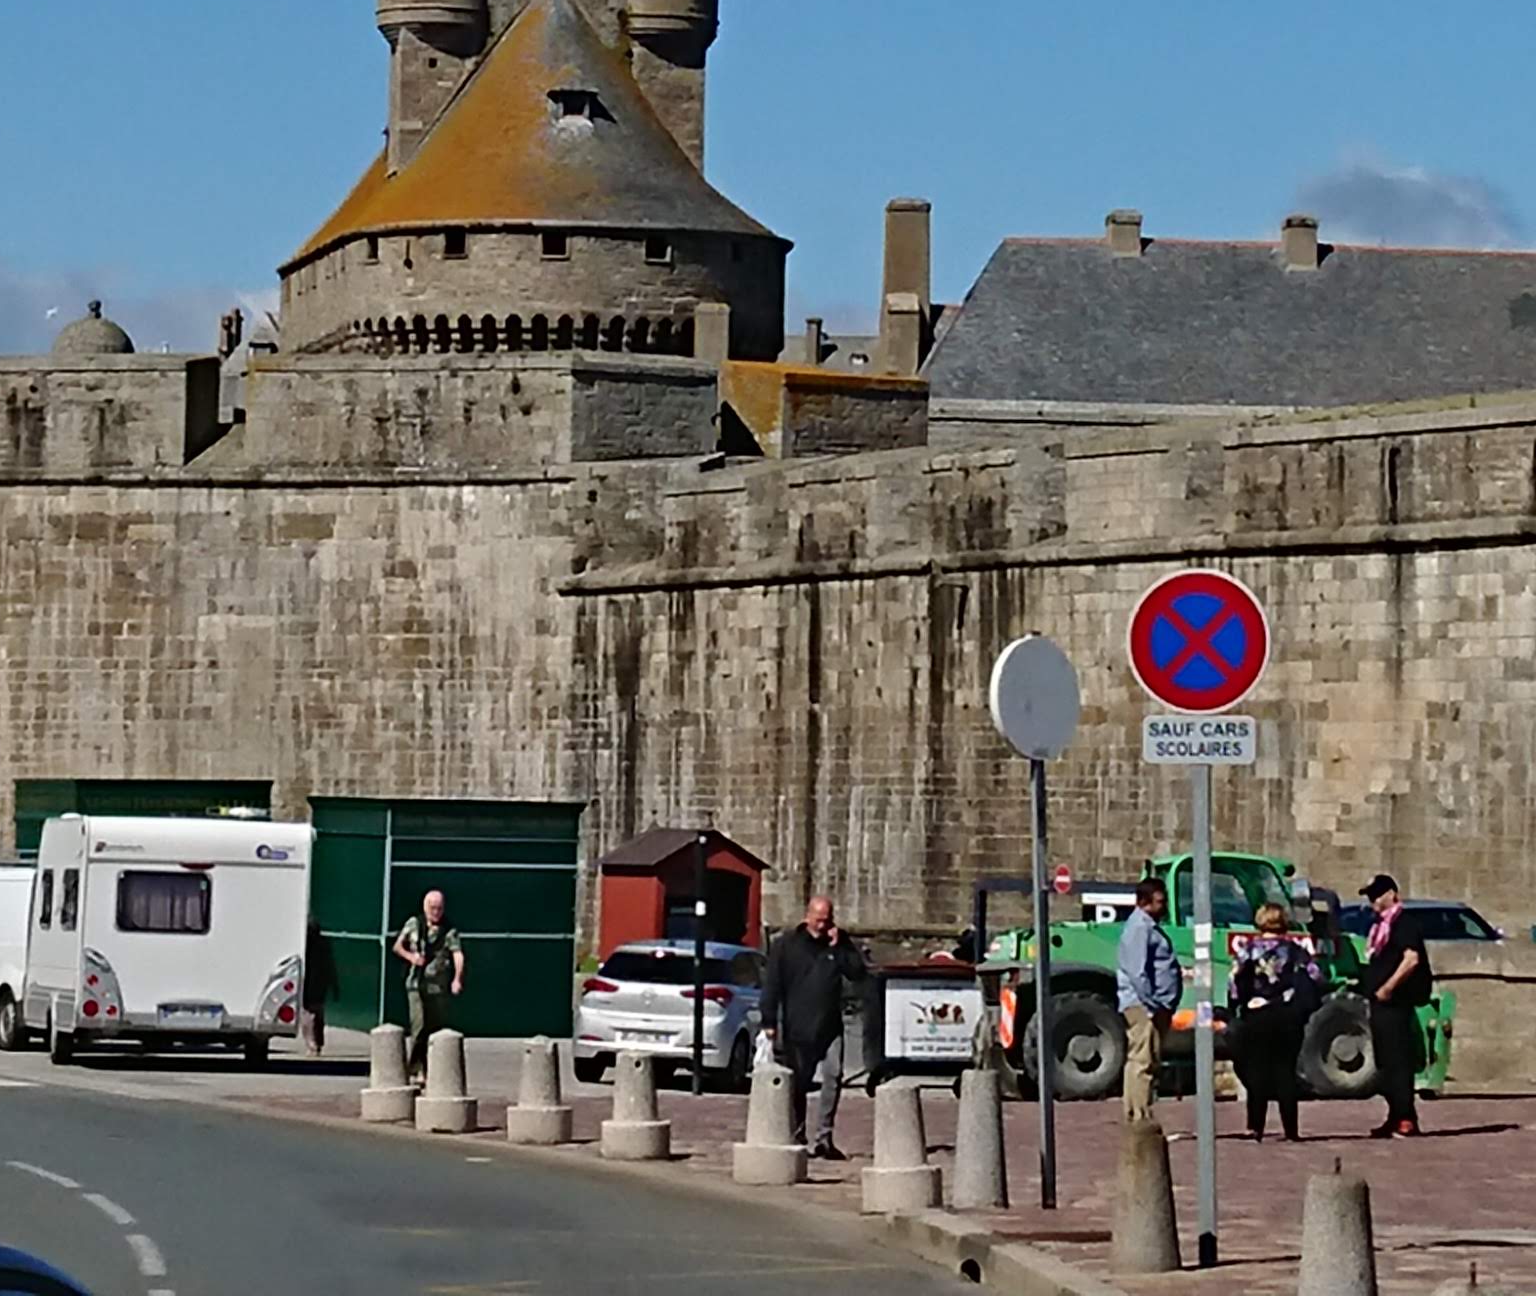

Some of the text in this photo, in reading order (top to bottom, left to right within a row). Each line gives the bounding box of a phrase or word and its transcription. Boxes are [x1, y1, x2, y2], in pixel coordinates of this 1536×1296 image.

[1148, 722, 1249, 738] SAUF CARS
[1156, 742, 1243, 757] SCOLAIRES
